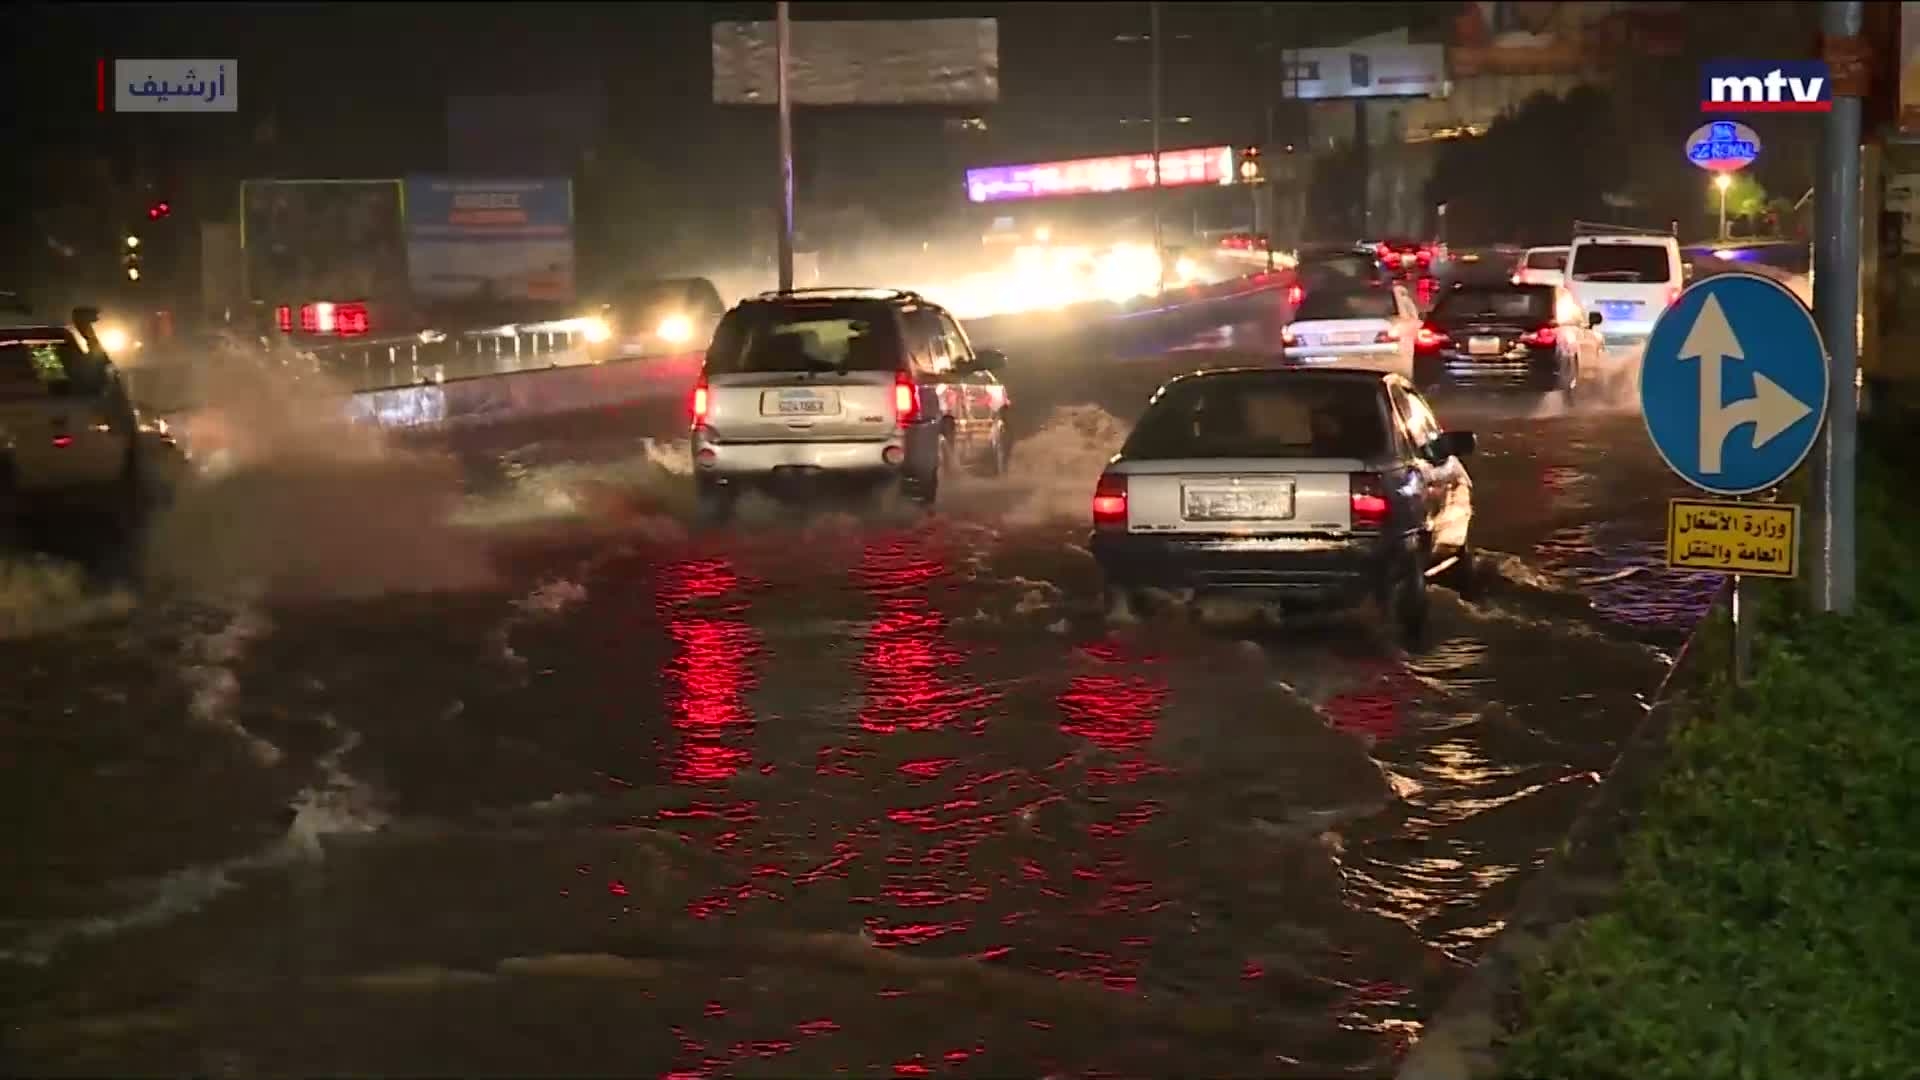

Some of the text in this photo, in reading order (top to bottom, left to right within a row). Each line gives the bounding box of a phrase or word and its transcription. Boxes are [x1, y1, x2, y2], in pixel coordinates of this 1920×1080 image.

[1743, 515, 1787, 539] وزارة
[1680, 540, 1783, 564] العامة والنقل
